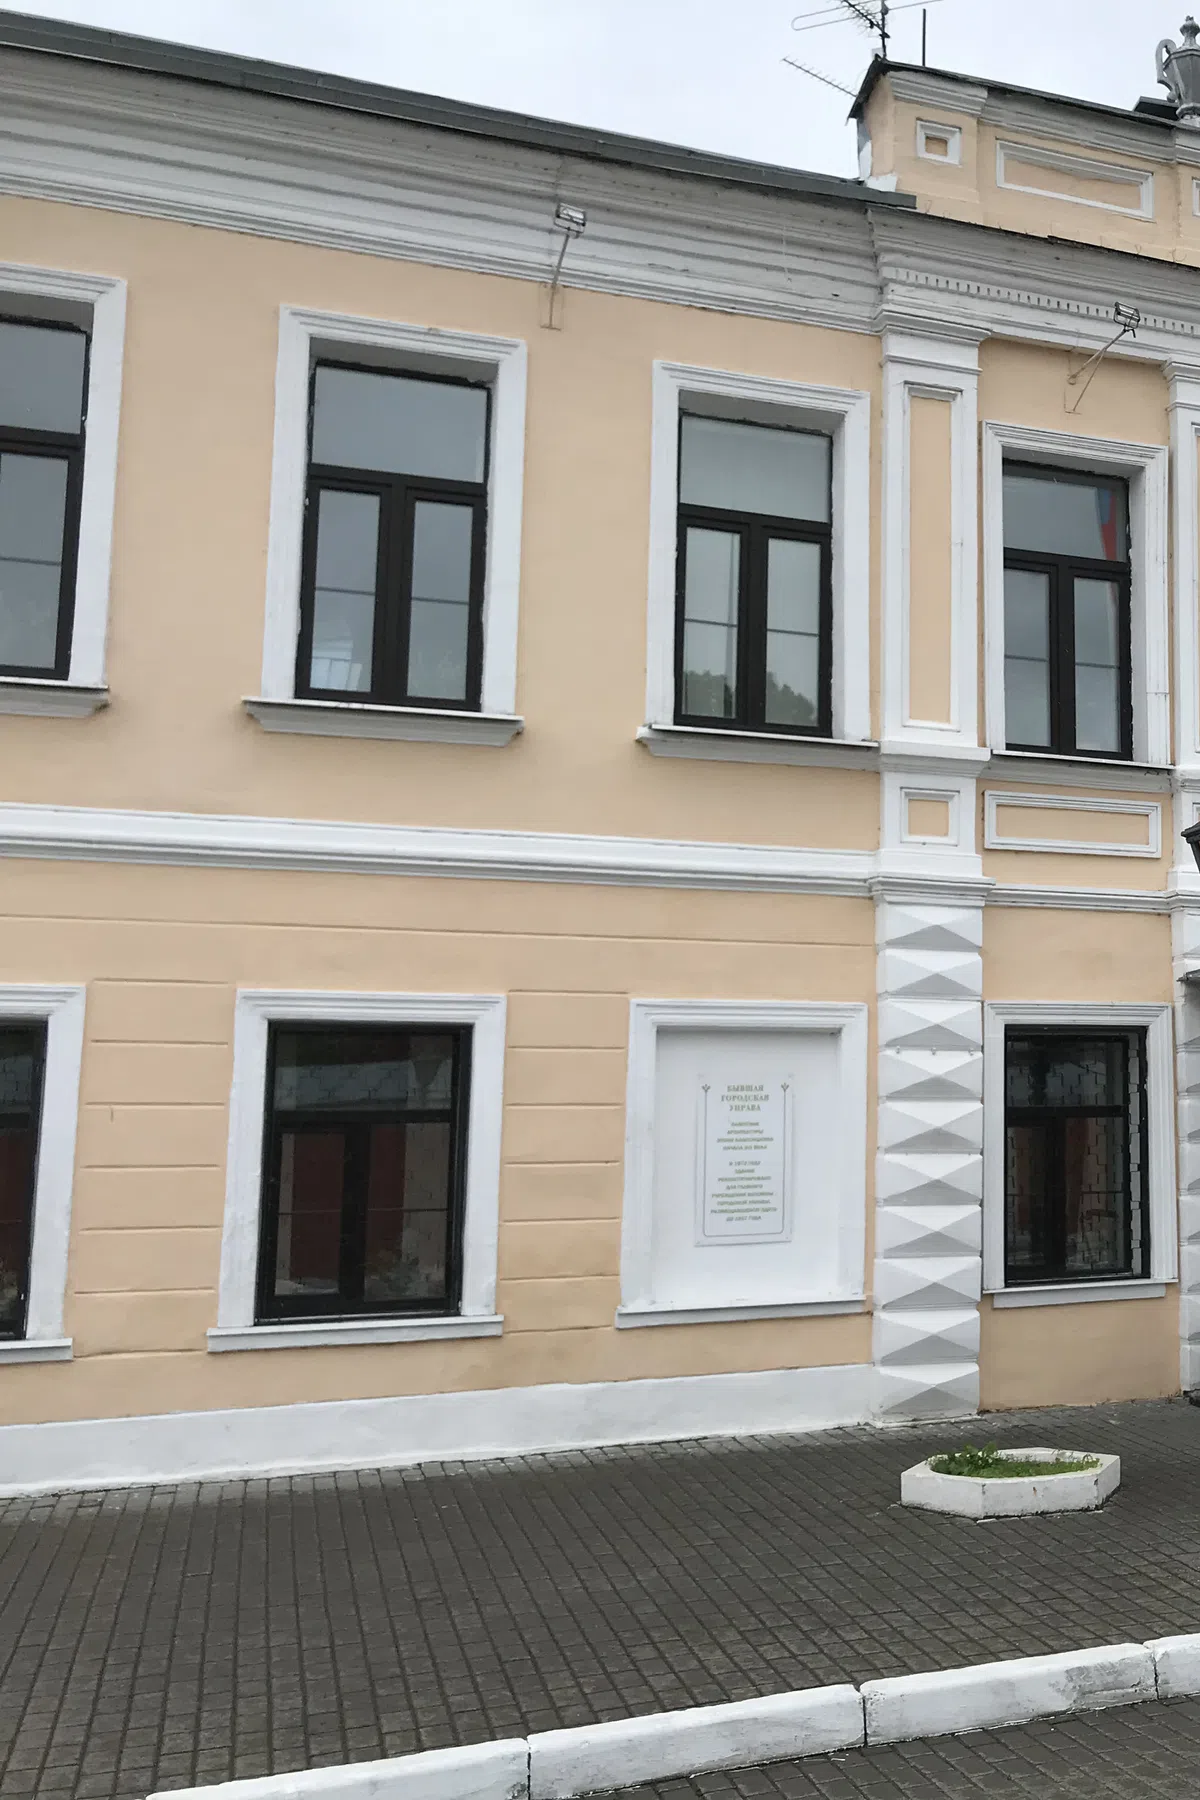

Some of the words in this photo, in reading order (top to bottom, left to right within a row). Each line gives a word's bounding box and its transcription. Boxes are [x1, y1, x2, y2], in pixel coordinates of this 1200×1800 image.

[727, 1084, 764, 1092] БЫВШАЯ
[721, 1094, 770, 1102] ГОРОДСКАЯ
[729, 1104, 761, 1112] УПРАВА
